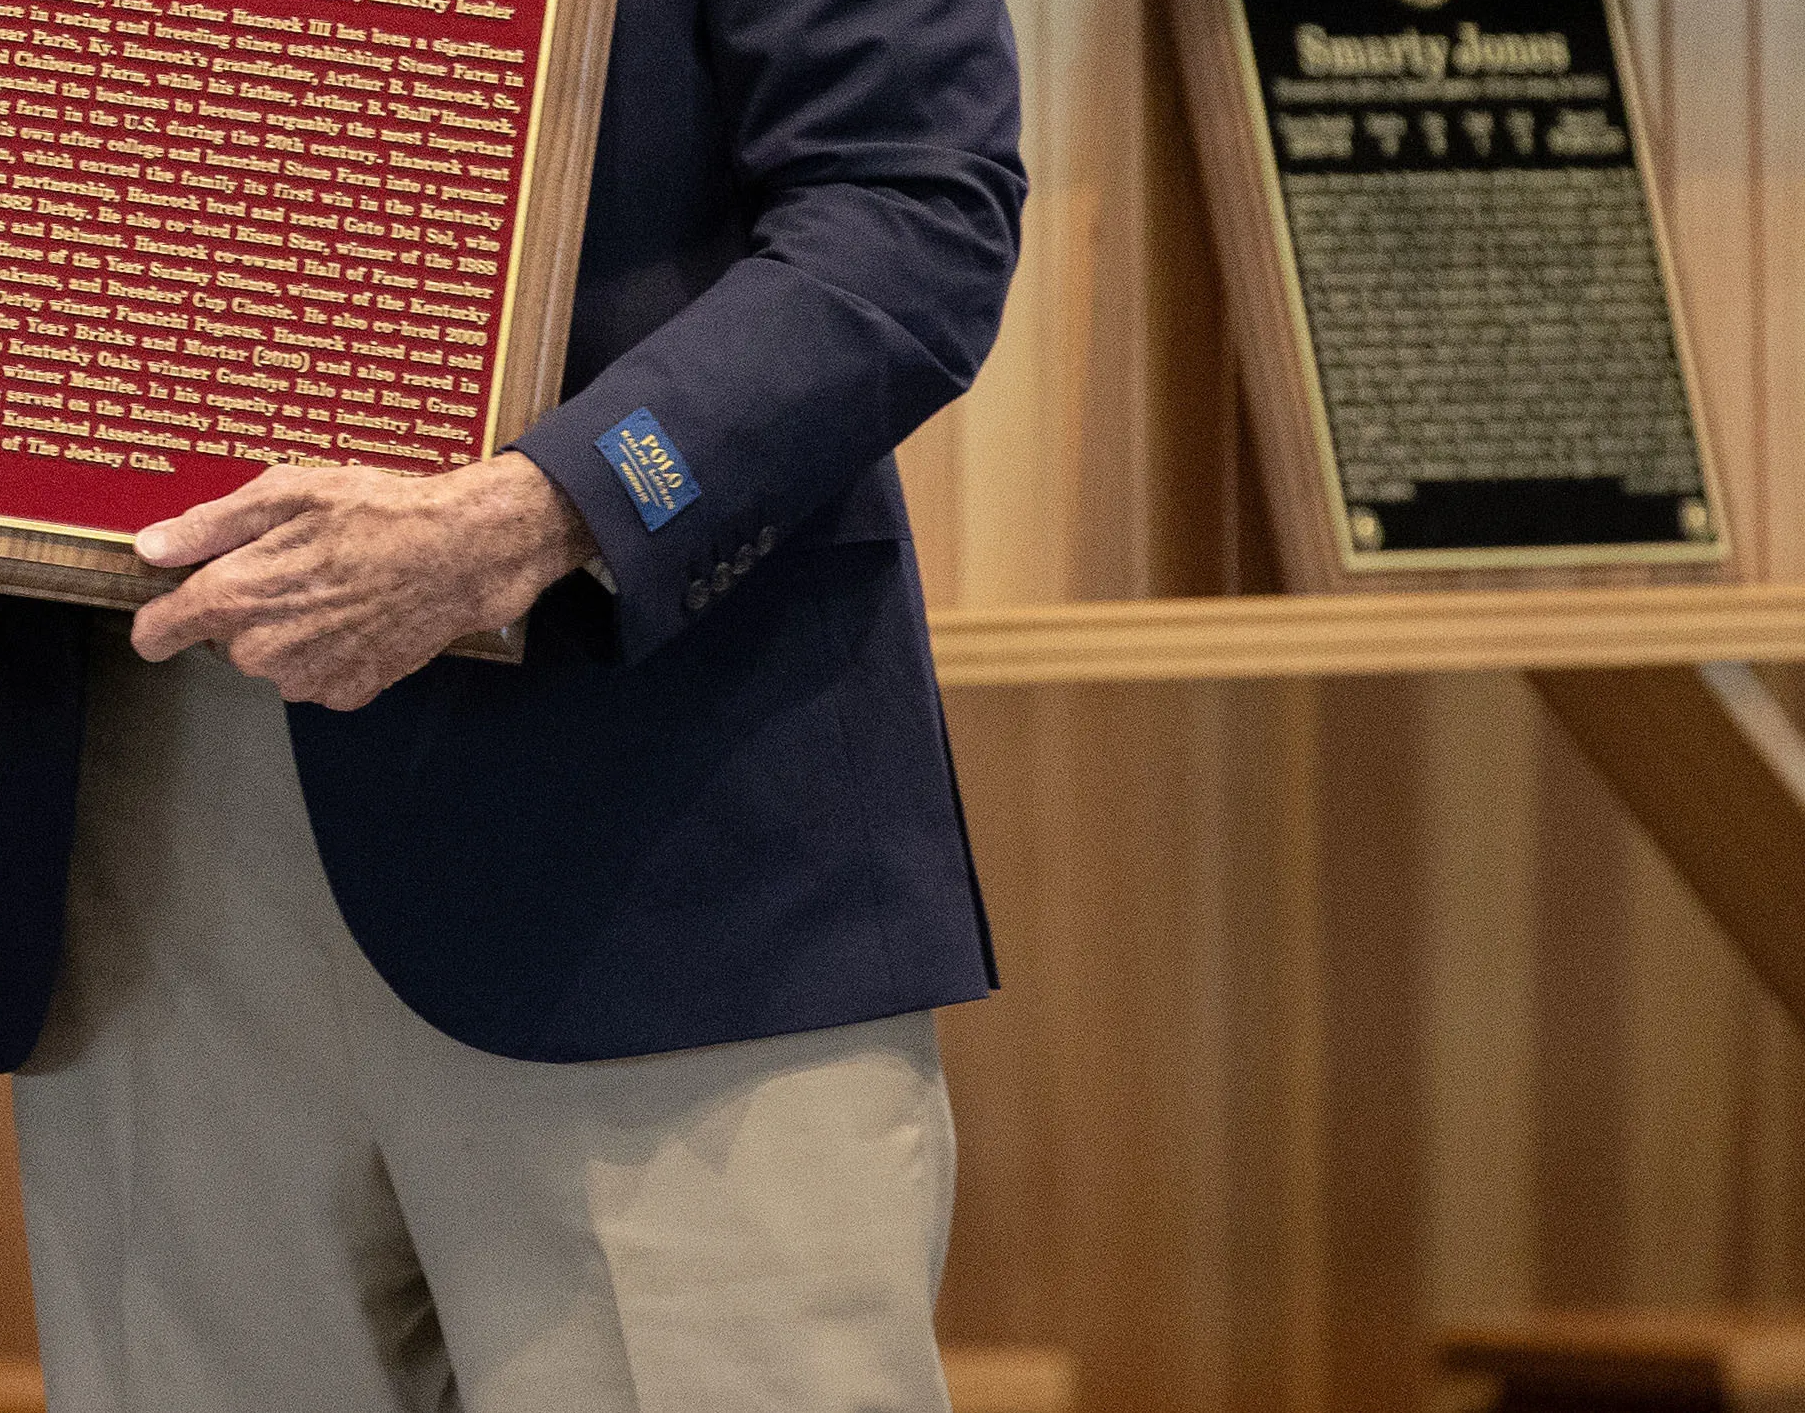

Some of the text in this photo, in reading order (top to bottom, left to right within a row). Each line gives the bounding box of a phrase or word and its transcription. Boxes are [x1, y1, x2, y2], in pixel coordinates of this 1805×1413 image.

[29, 5, 48, 21] in
[115, 20, 149, 35] and
[398, 55, 447, 76] Stone
[453, 63, 498, 83] Farm
[504, 70, 523, 87] in
[167, 1, 227, 21] Arthur
[232, 8, 302, 32] Hancock
[307, 18, 331, 36] III
[336, 23, 366, 41] has
[207, 77, 234, 94] his
[302, 91, 362, 112] Arthur
[323, 70, 384, 91] Arthur
[61, 82, 90, 98] the
[346, 121, 375, 138] the
[64, 105, 82, 122] in
[89, 109, 117, 126] the
[230, 129, 259, 146] the
[389, 151, 462, 174] Hancock
[168, 147, 200, 162] and
[284, 160, 331, 180] Stone
[336, 167, 380, 187] Farm
[126, 186, 199, 210] Hancock
[250, 206, 284, 221] and
[145, 165, 174, 182] the
[359, 194, 378, 211] in
[385, 198, 414, 215] the
[420, 203, 502, 230] Kentucky
[11, 221, 44, 237] and
[134, 235, 208, 259] Hancock
[345, 266, 367, 281] of
[97, 206, 121, 223] He
[125, 211, 161, 228] also
[400, 249, 421, 264] of
[424, 252, 452, 269] the
[47, 249, 68, 264] of
[72, 251, 100, 268] the
[105, 255, 144, 274] Year
[351, 291, 373, 306] of
[376, 294, 404, 310] the
[410, 297, 489, 324] Kentucky
[68, 277, 101, 293] and
[303, 306, 327, 324] He
[332, 312, 367, 329] also
[8, 338, 91, 365] Kentucky
[341, 388, 375, 403] and
[26, 316, 68, 336] Year
[141, 336, 176, 351] and
[315, 360, 351, 375] and
[357, 364, 395, 381] also
[273, 326, 345, 350] Hancock
[409, 349, 442, 364] and
[95, 399, 124, 416] the
[130, 403, 211, 430] Kentucky
[216, 415, 266, 436] Horse
[173, 385, 201, 403] his
[1, 435, 23, 450] of
[195, 440, 228, 455] and
[640, 434, 684, 488] POLO
